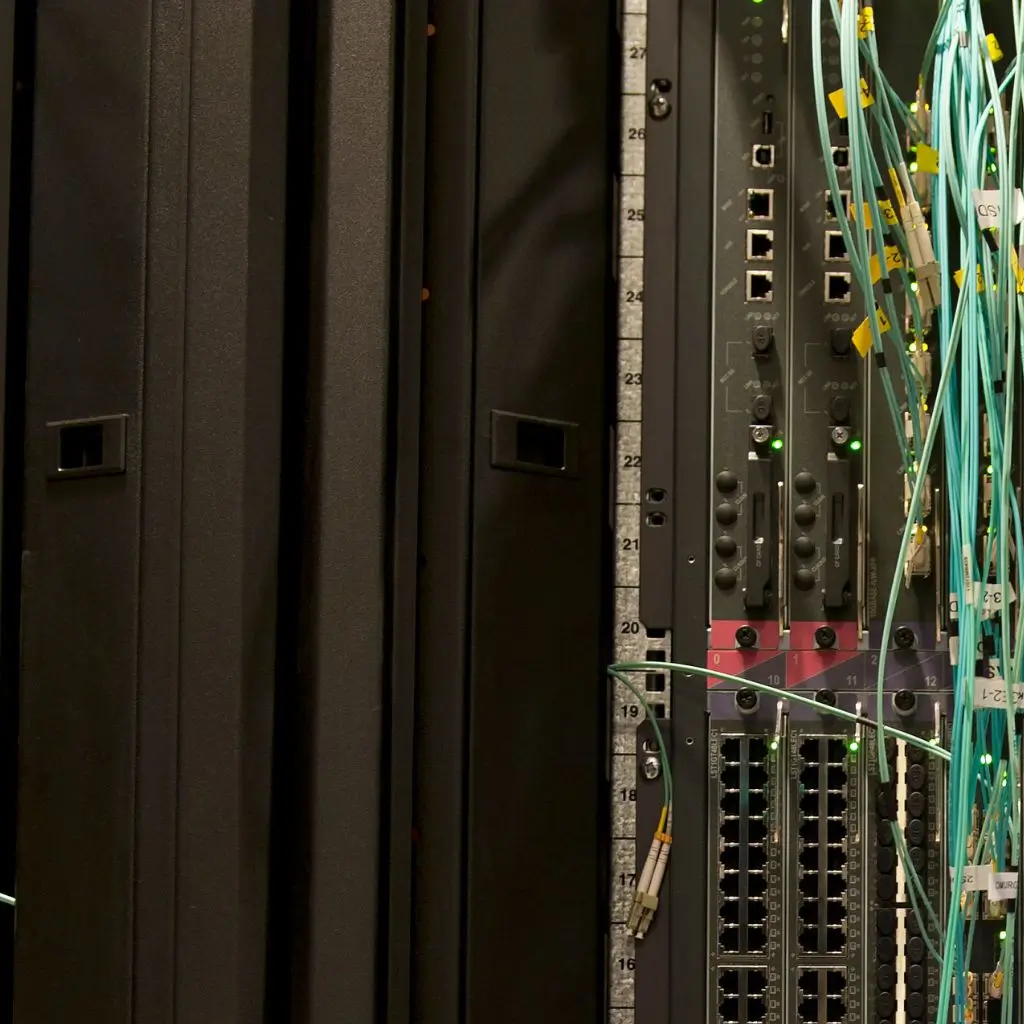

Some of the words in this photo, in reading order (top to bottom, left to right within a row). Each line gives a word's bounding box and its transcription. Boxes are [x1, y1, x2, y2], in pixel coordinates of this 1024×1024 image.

[630, 47, 646, 59] 27
[629, 128, 645, 140] 26
[627, 209, 644, 221] 25
[626, 291, 643, 303] 24
[624, 373, 642, 385] 23
[623, 455, 641, 468] 22
[623, 538, 639, 551] 21
[621, 621, 639, 634] 20
[713, 655, 720, 666] 0
[793, 655, 799, 666] 1
[871, 655, 878, 666] 2
[768, 674, 781, 686] 10
[846, 674, 858, 686] 11
[925, 675, 938, 687] 12
[621, 705, 638, 718] 19
[620, 788, 637, 802] 18
[619, 873, 636, 887] 17
[618, 958, 636, 971] 16
